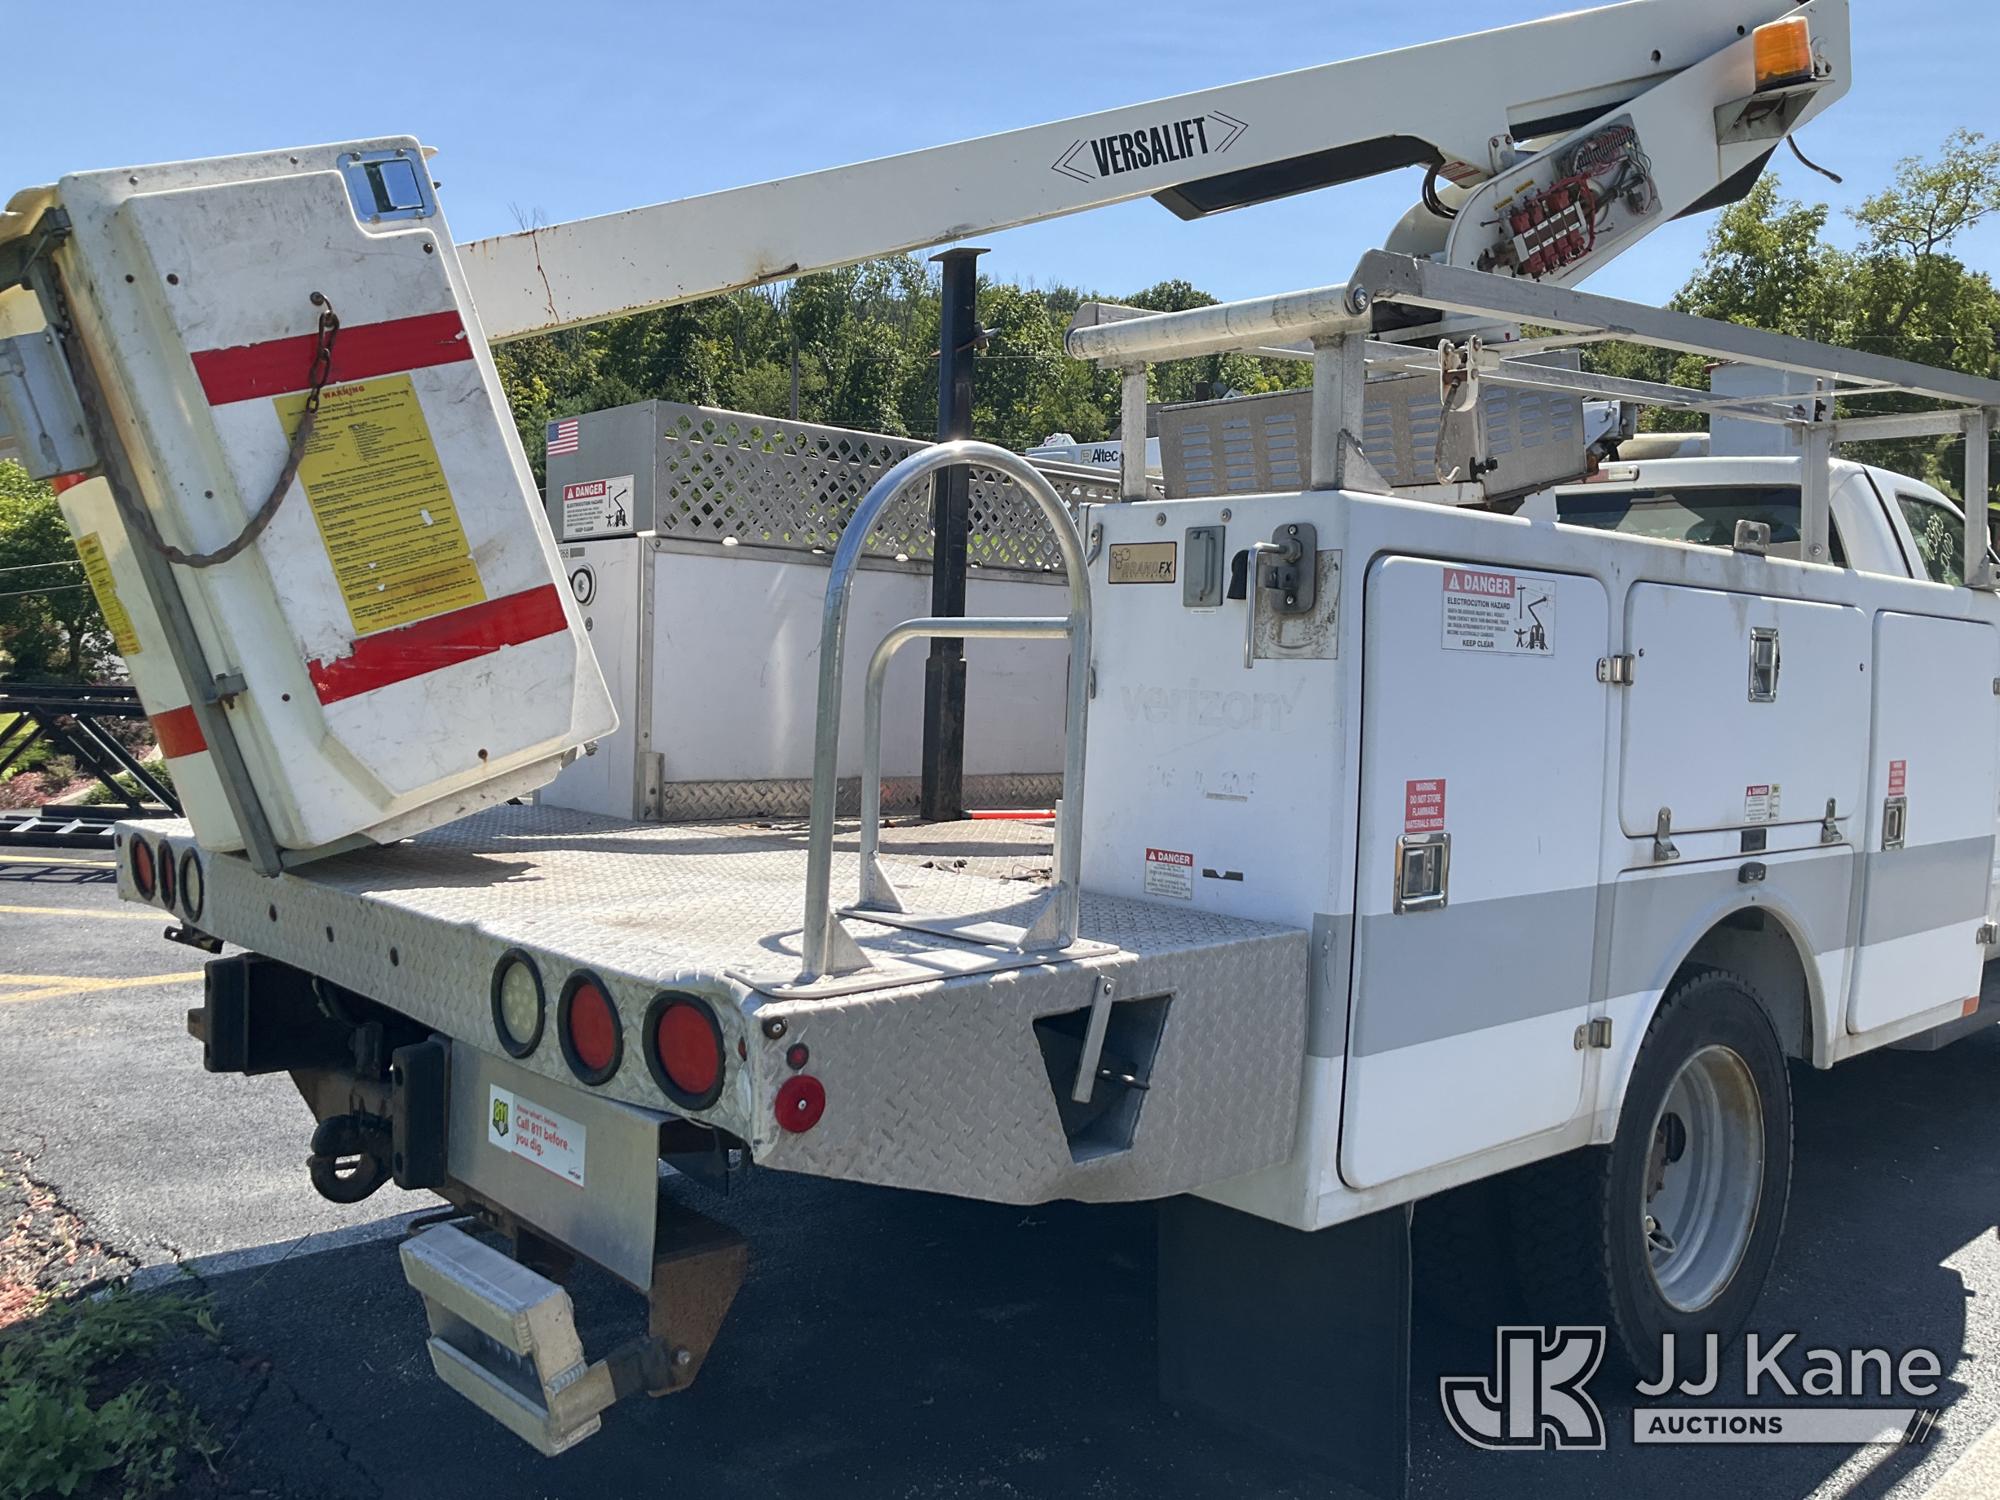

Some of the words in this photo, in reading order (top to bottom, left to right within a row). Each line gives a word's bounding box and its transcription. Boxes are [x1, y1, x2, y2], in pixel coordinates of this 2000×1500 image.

[1090, 117, 1208, 177] VERSALIFT
[323, 385, 365, 399] WARNING
[1092, 449, 1119, 463] Altec
[575, 484, 603, 497] DANGER
[1464, 574, 1510, 594] DANGER
[1448, 597, 1489, 607] ELECTROCUTION
[1491, 601, 1510, 610] HAZARD
[1158, 852, 1190, 865] DANGER
[515, 1133, 529, 1146] you
[516, 1115, 529, 1130] Call
[531, 1122, 542, 1136] 811
[544, 1128, 568, 1151] before
